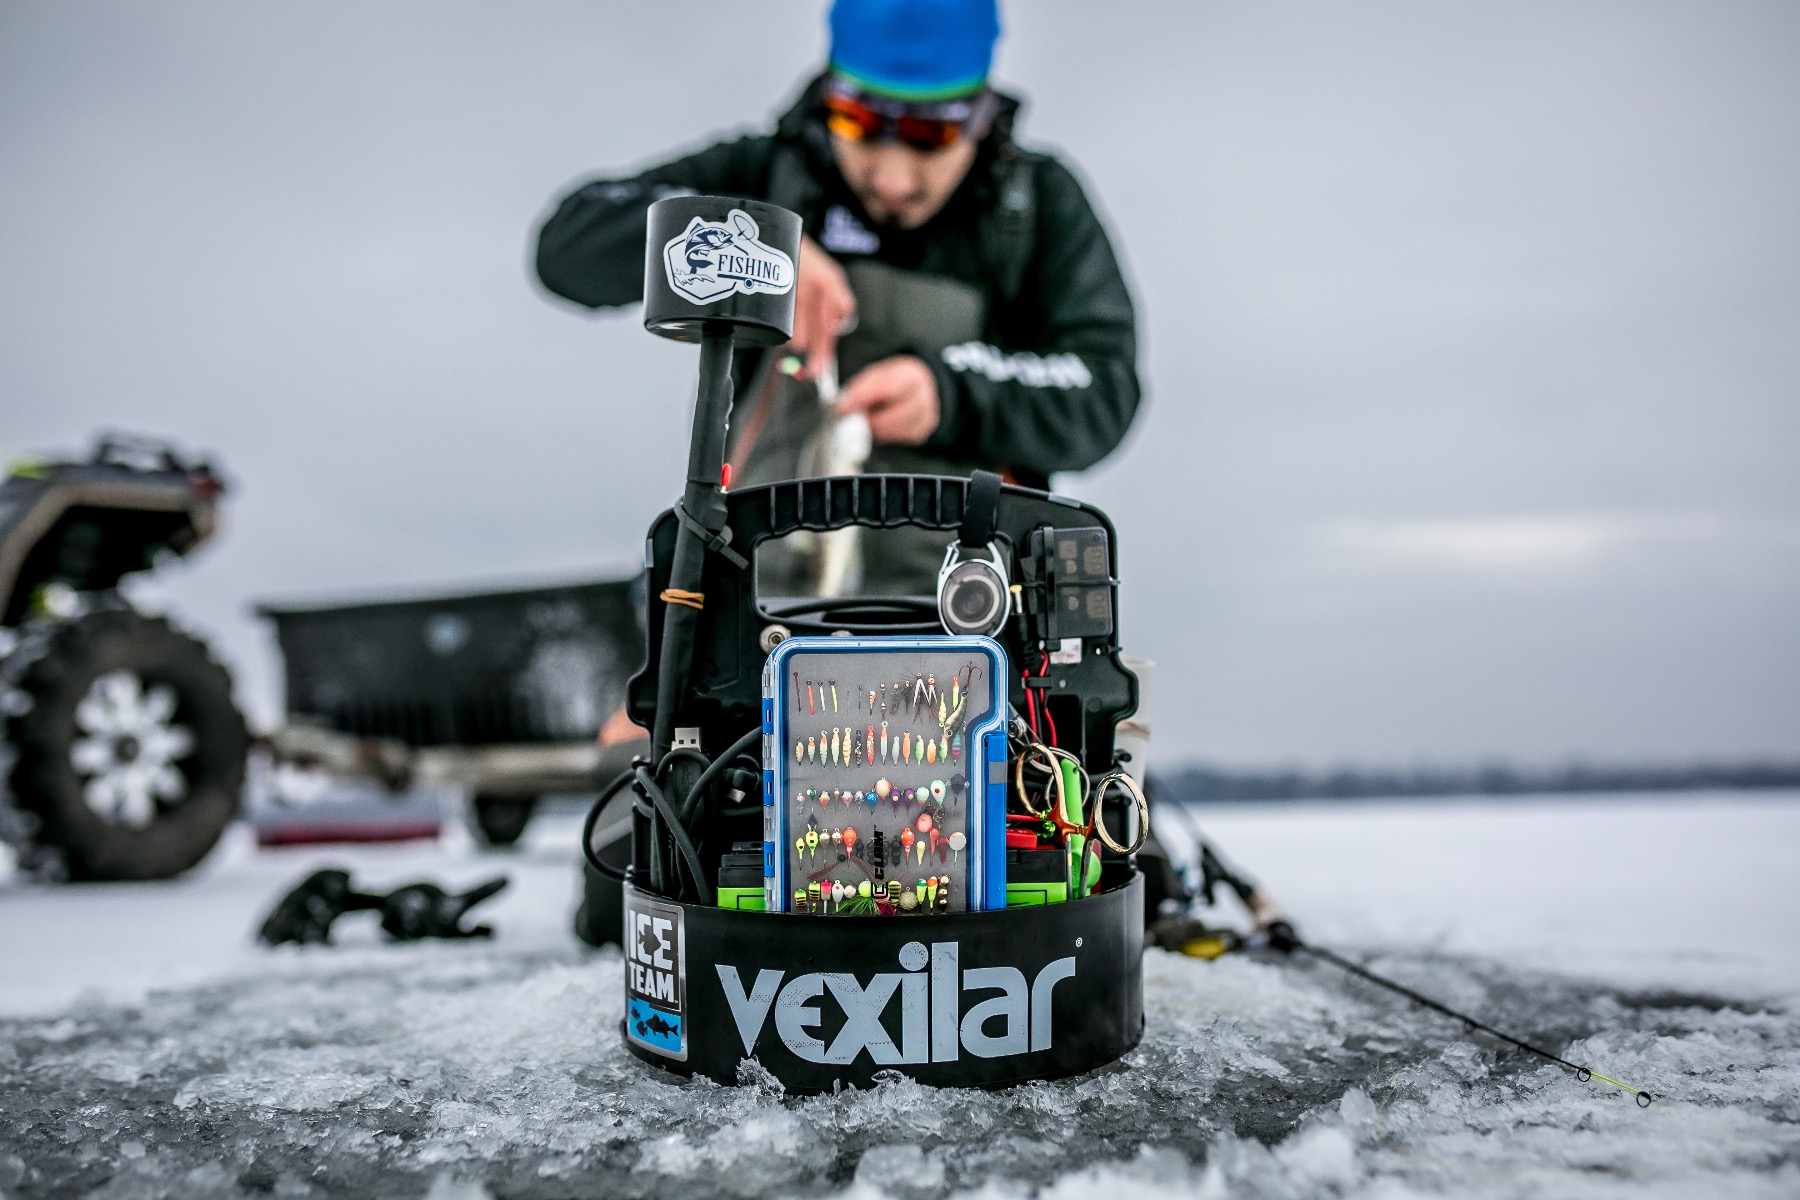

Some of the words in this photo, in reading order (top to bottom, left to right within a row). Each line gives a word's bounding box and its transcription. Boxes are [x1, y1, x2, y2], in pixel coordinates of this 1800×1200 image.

[717, 254, 780, 281] FISHING
[874, 830, 885, 880] CLAM
[629, 910, 673, 970] ICE
[629, 961, 675, 1003] TEAM
